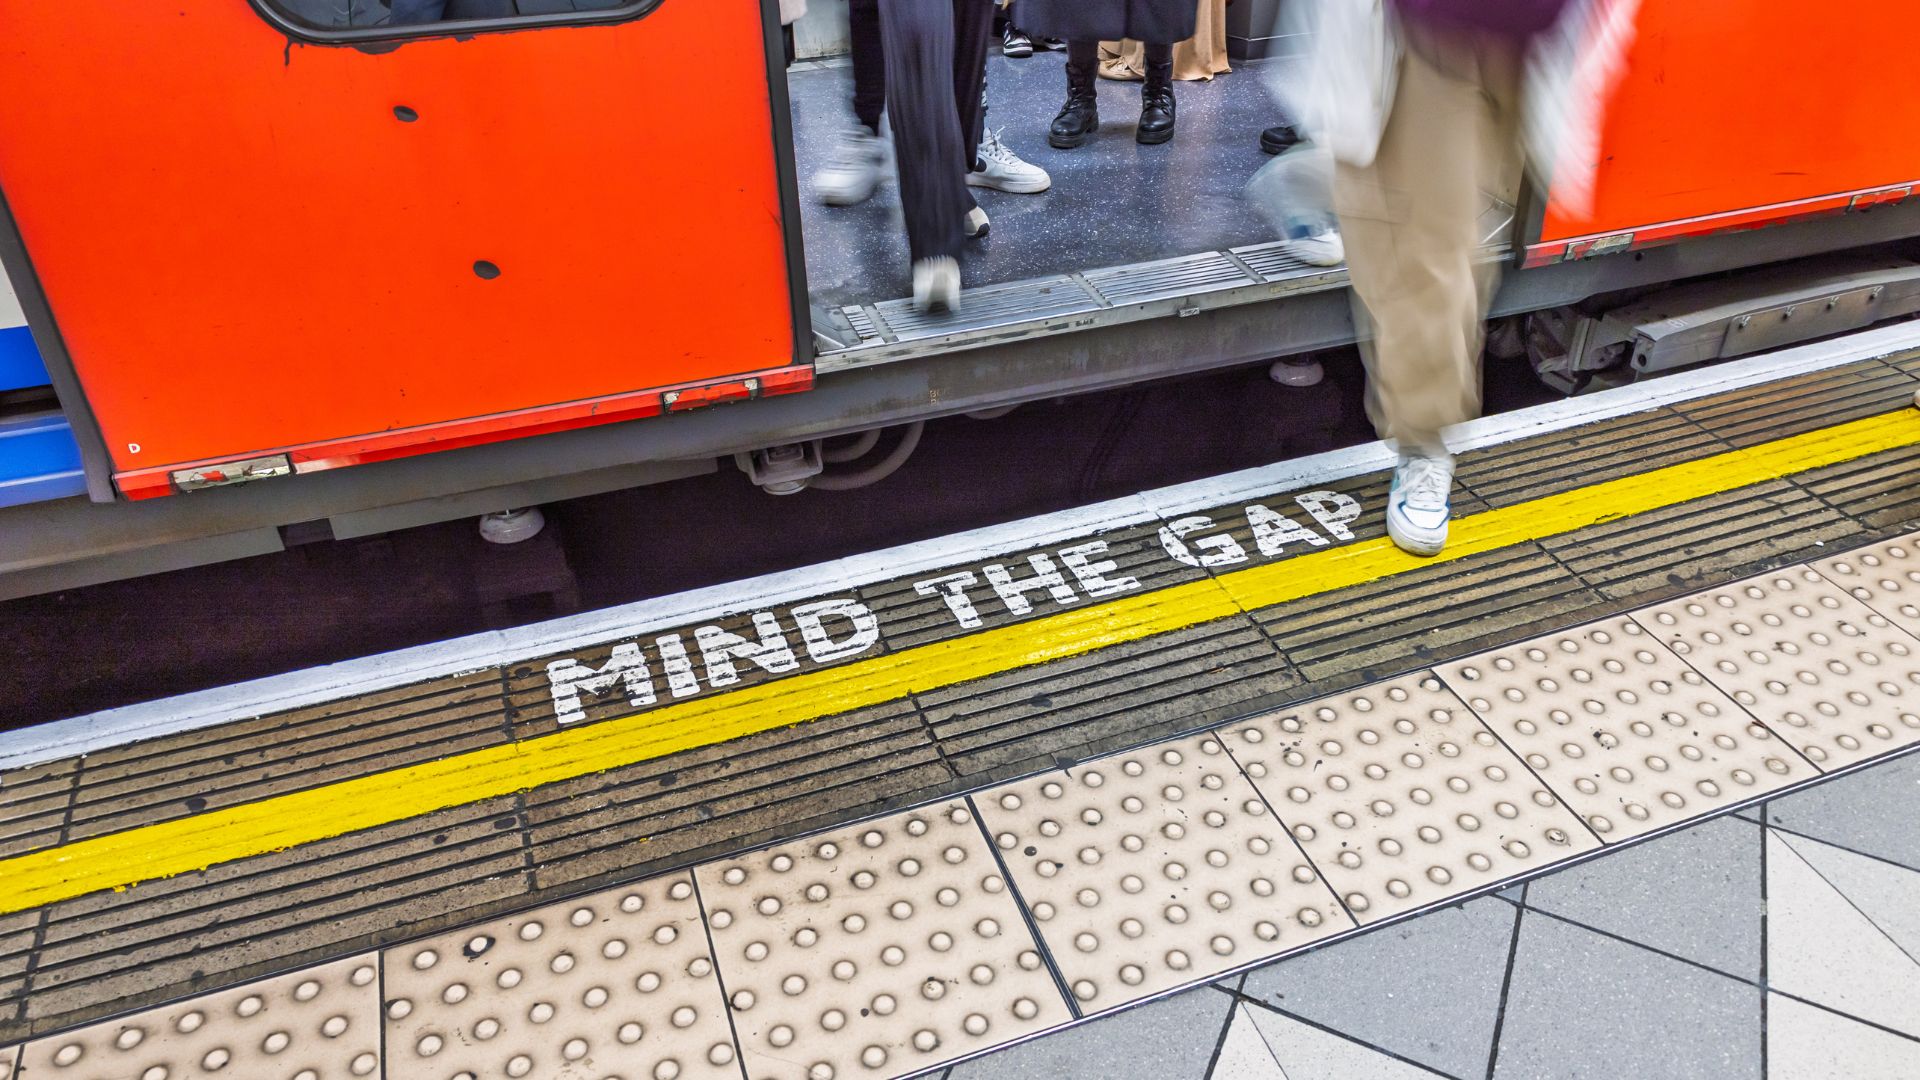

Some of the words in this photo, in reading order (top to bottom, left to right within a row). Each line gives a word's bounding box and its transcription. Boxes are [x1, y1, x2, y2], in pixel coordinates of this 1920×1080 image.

[128, 443, 141, 454] D
[546, 599, 879, 724] MIND
[913, 540, 1141, 629] THE
[1157, 490, 1362, 567] GAP
